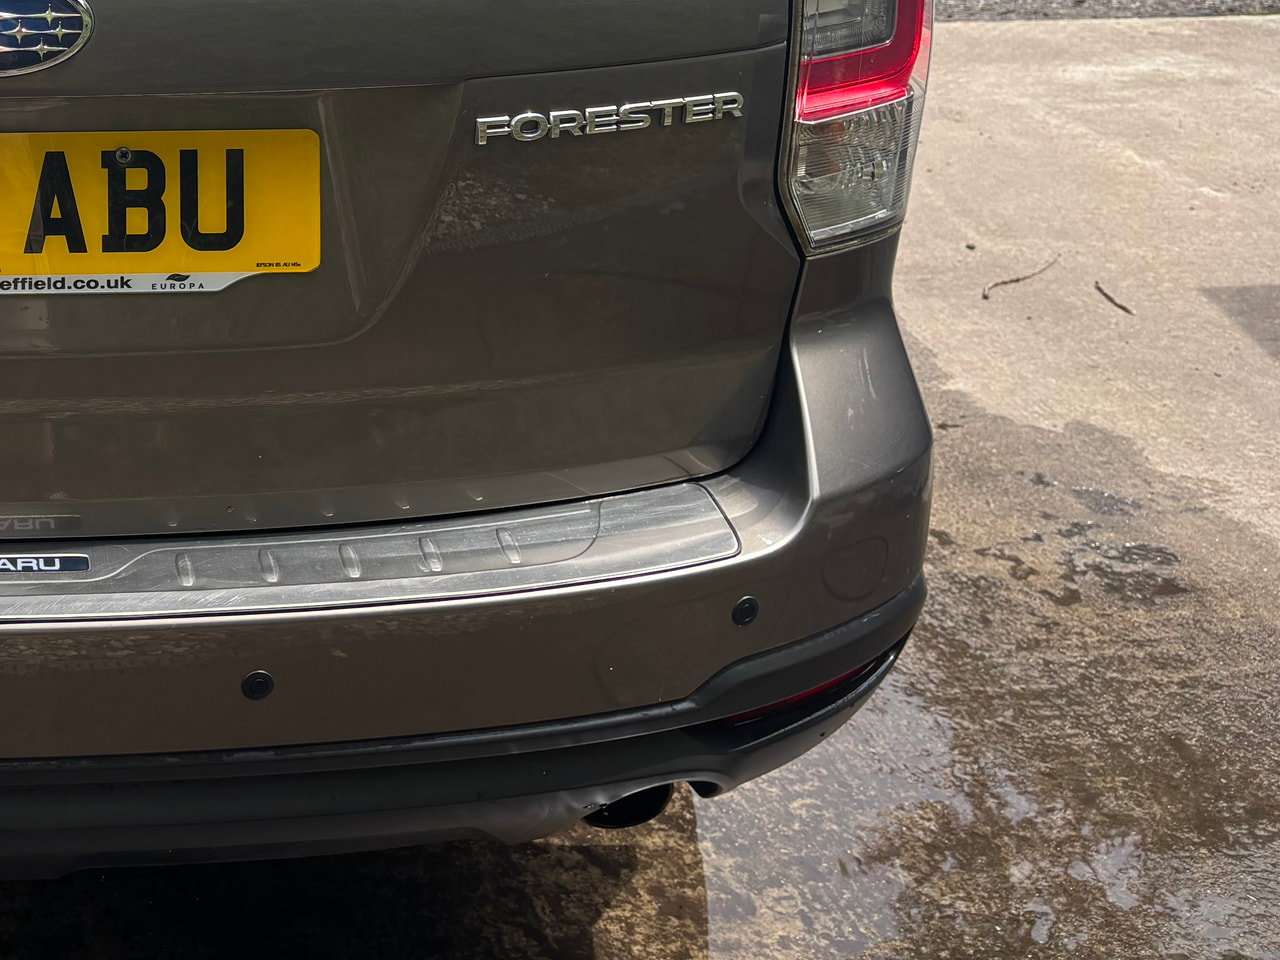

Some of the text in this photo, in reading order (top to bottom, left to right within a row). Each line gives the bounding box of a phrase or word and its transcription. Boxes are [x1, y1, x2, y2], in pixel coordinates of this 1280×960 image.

[476, 91, 744, 144] FORESTER
[23, 148, 244, 254] ABU
[151, 282, 205, 290] EUROPA
